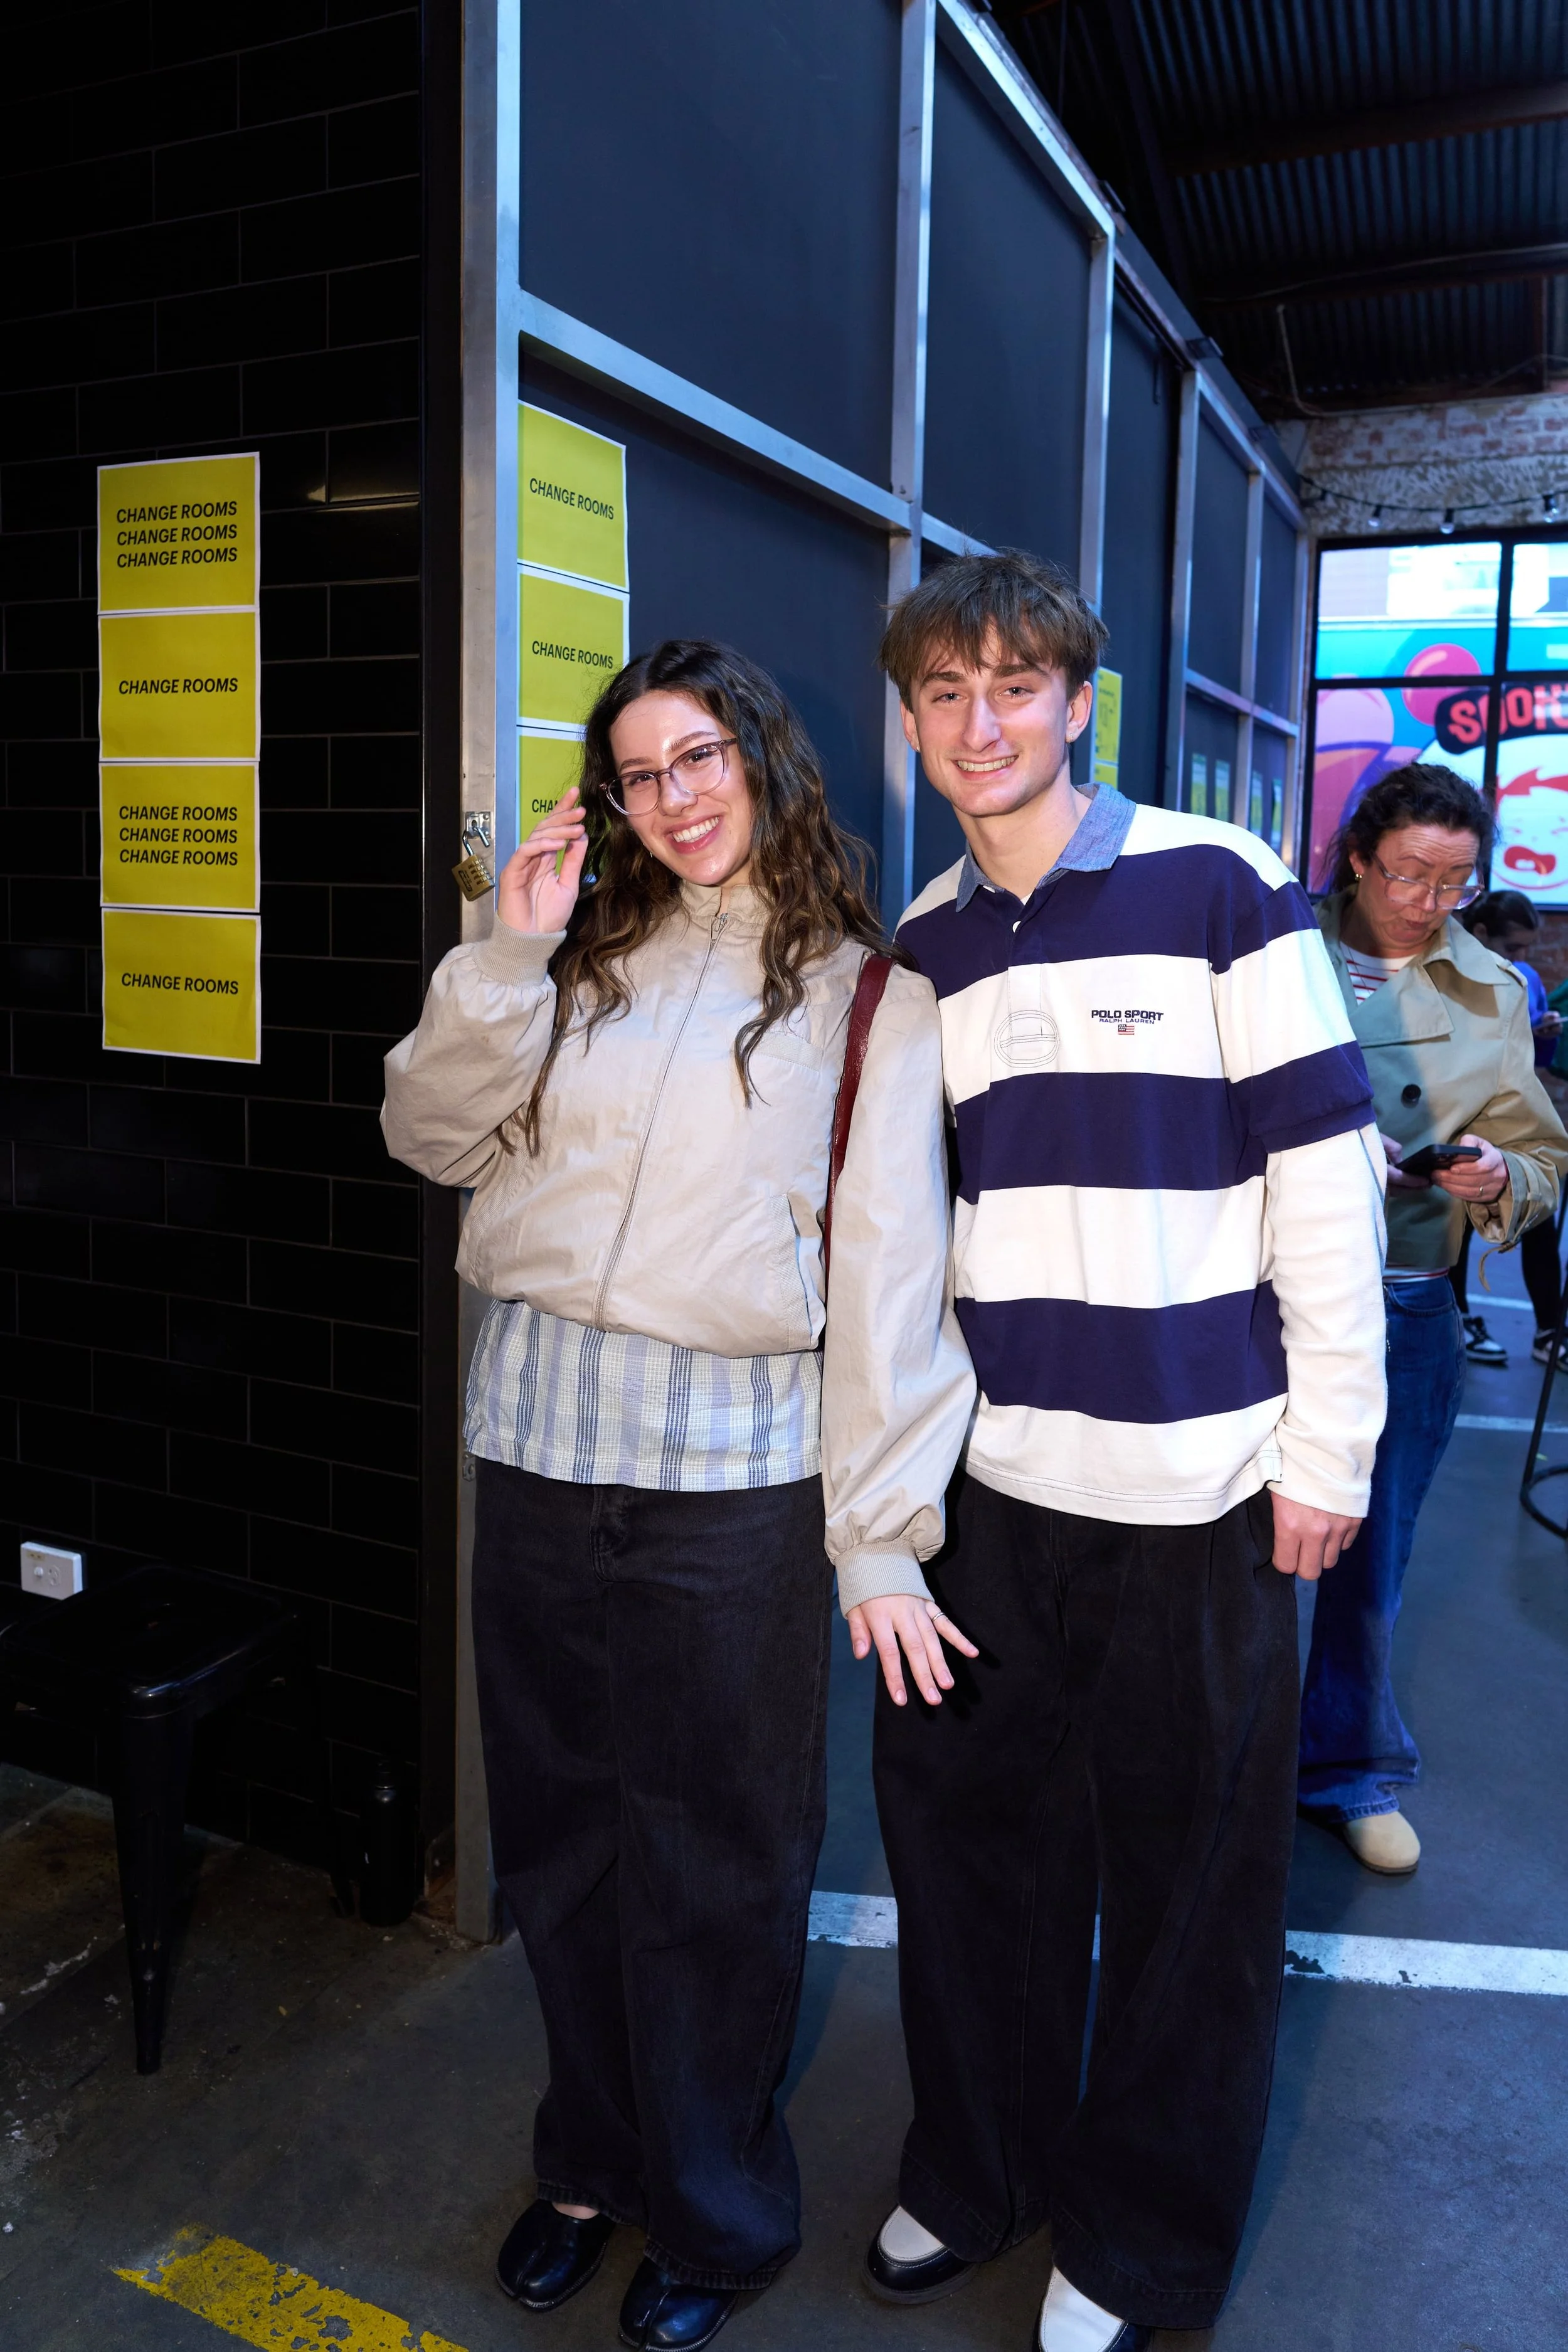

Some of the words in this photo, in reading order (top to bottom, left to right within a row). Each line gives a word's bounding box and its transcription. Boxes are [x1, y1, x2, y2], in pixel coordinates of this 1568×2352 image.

[529, 477, 576, 507] CHANGE
[578, 494, 614, 520] ROOMS
[117, 504, 178, 524] CHANGE
[181, 501, 237, 519] ROOMS
[117, 527, 178, 546] CHANGE
[181, 524, 238, 542] ROOMS
[117, 549, 178, 568] CHANGE
[181, 547, 238, 564] ROOMS
[532, 640, 576, 662] CHANGE
[578, 649, 613, 669] ROOMS
[119, 679, 179, 694] CHANGE
[183, 677, 238, 693] ROOMS
[119, 805, 179, 820] CHANGE
[182, 806, 238, 822] ROOMS
[119, 827, 179, 842] CHANGE
[183, 829, 238, 844] ROOMS
[120, 849, 180, 864] CHANGE
[183, 850, 238, 866] ROOMS
[122, 972, 181, 990] CHANGE
[184, 977, 238, 995] ROOMS
[1091, 1010, 1121, 1018] POLO
[1124, 1010, 1163, 1020] SPORT
